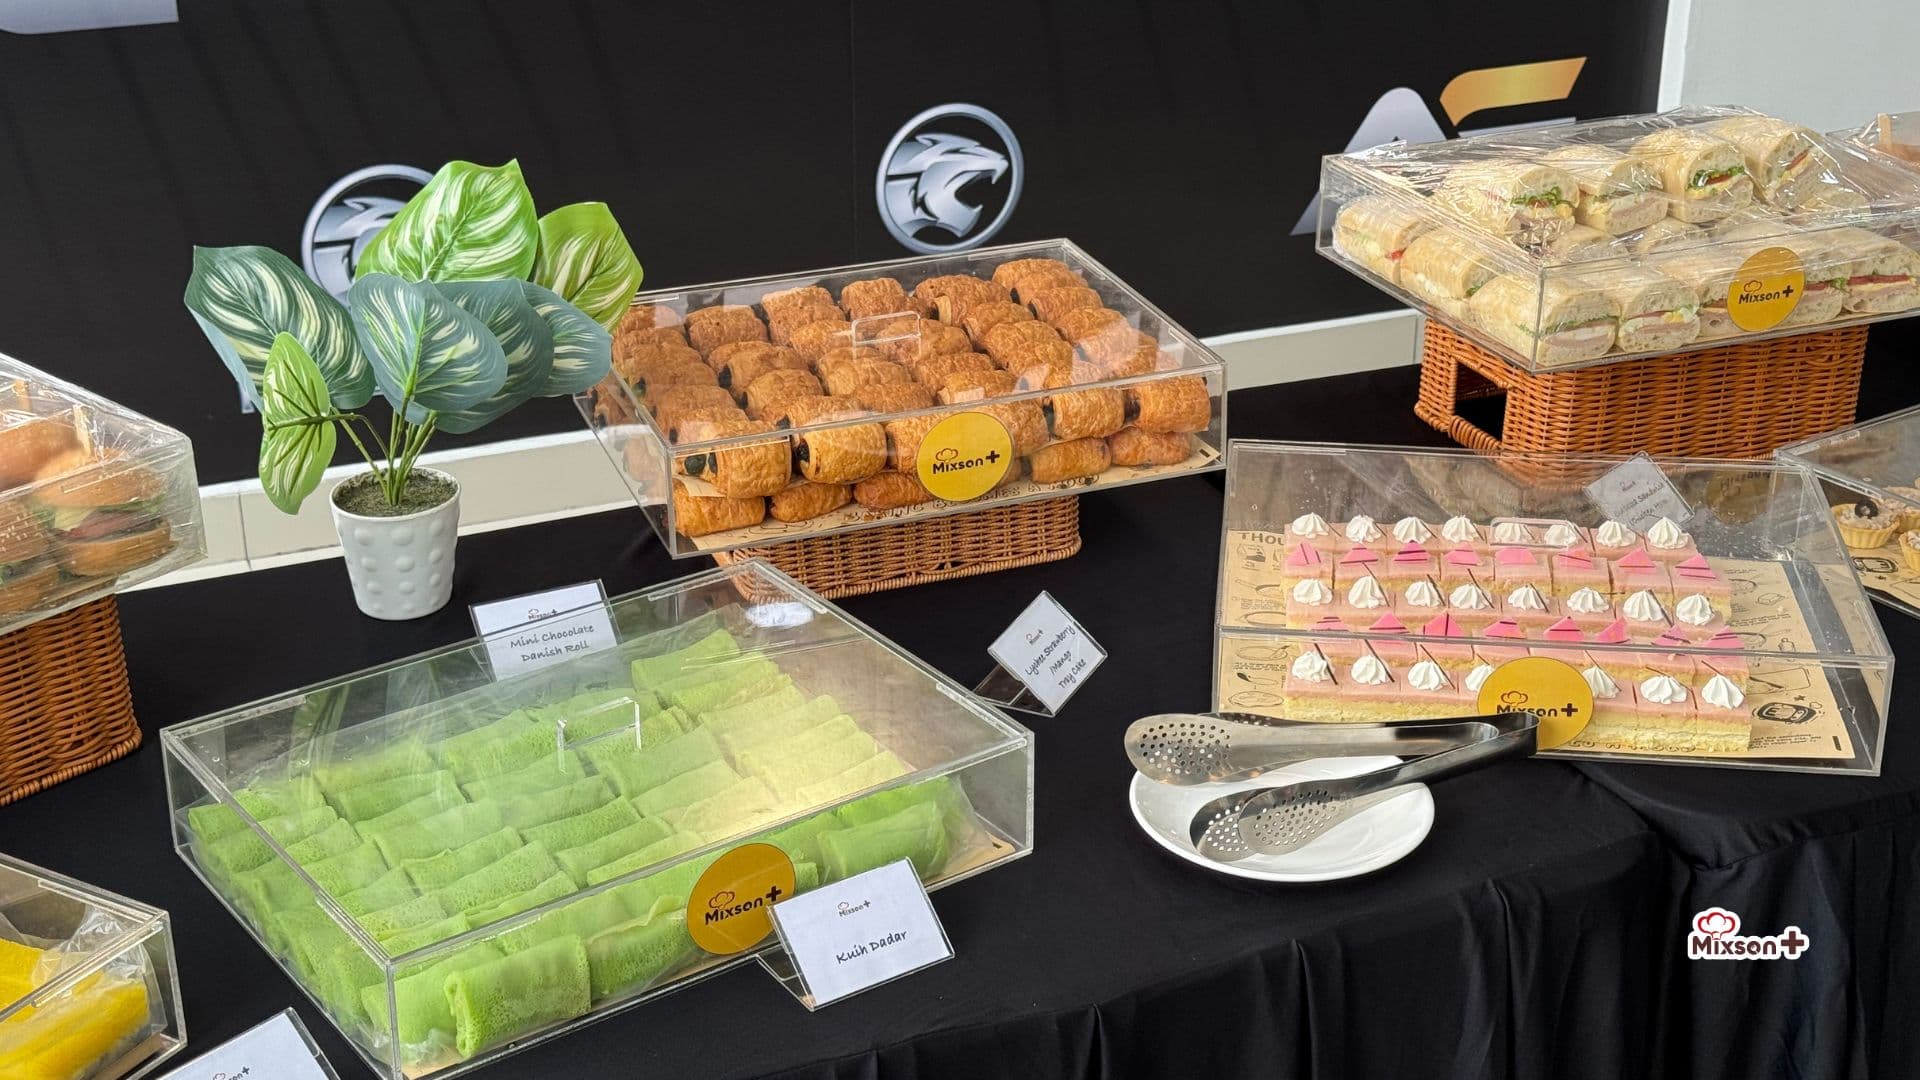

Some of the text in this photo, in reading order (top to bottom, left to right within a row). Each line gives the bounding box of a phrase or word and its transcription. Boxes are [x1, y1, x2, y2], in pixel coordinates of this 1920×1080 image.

[932, 450, 1001, 475] Mixson+
[510, 625, 595, 648] Mini Chocolate
[521, 640, 590, 662] Danish Roll
[704, 885, 783, 926] Mixson+
[836, 930, 908, 965] Kuih Dadar
